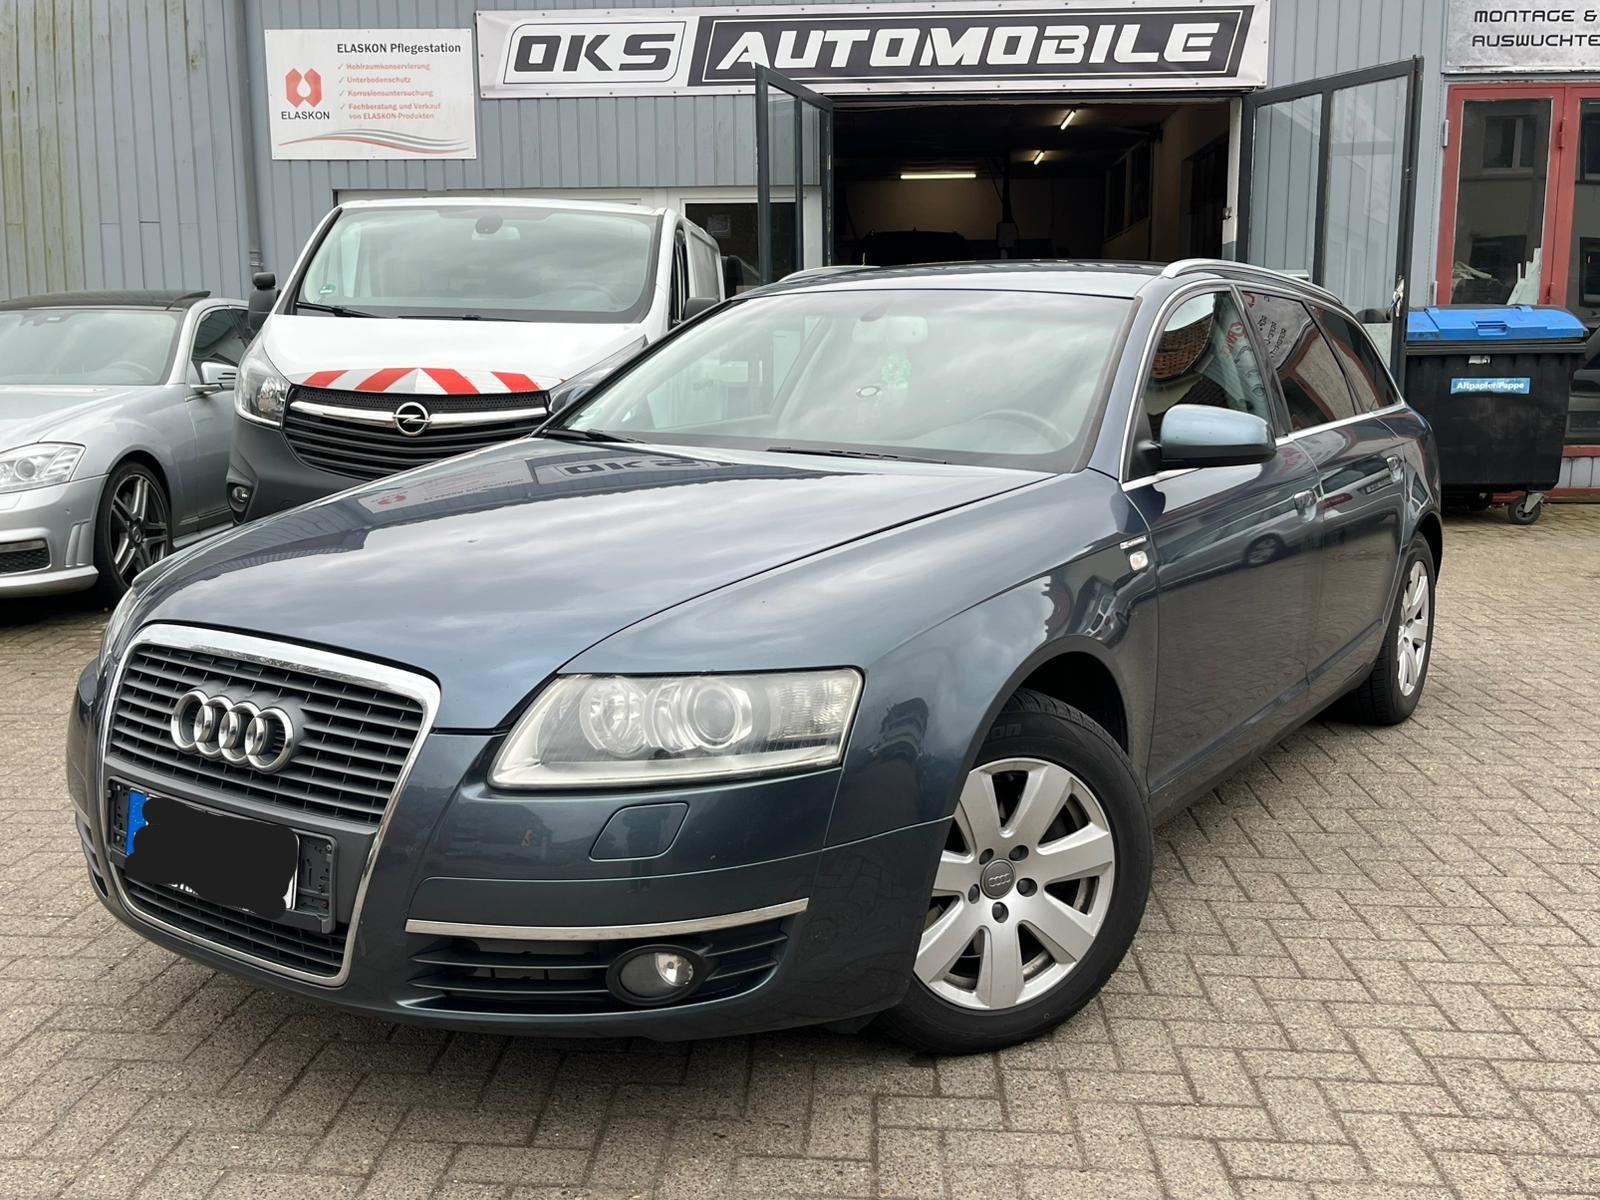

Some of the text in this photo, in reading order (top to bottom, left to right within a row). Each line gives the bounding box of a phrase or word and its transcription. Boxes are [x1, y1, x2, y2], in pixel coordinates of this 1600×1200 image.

[1474, 10, 1598, 22] MONTAGE &
[1472, 34, 1600, 47] AUSWUCHTE
[337, 43, 461, 54] ELASKON Pflegestation
[513, 23, 1220, 73] OKS AUTOMOBILE
[345, 62, 431, 71] Hohlraumkonservierung
[346, 76, 411, 84] Unterbodenschutz
[347, 89, 433, 98] Korrosionsuntersuchung
[348, 102, 441, 111] Fachberatung und Verkauf
[281, 111, 330, 120] ELASKON
